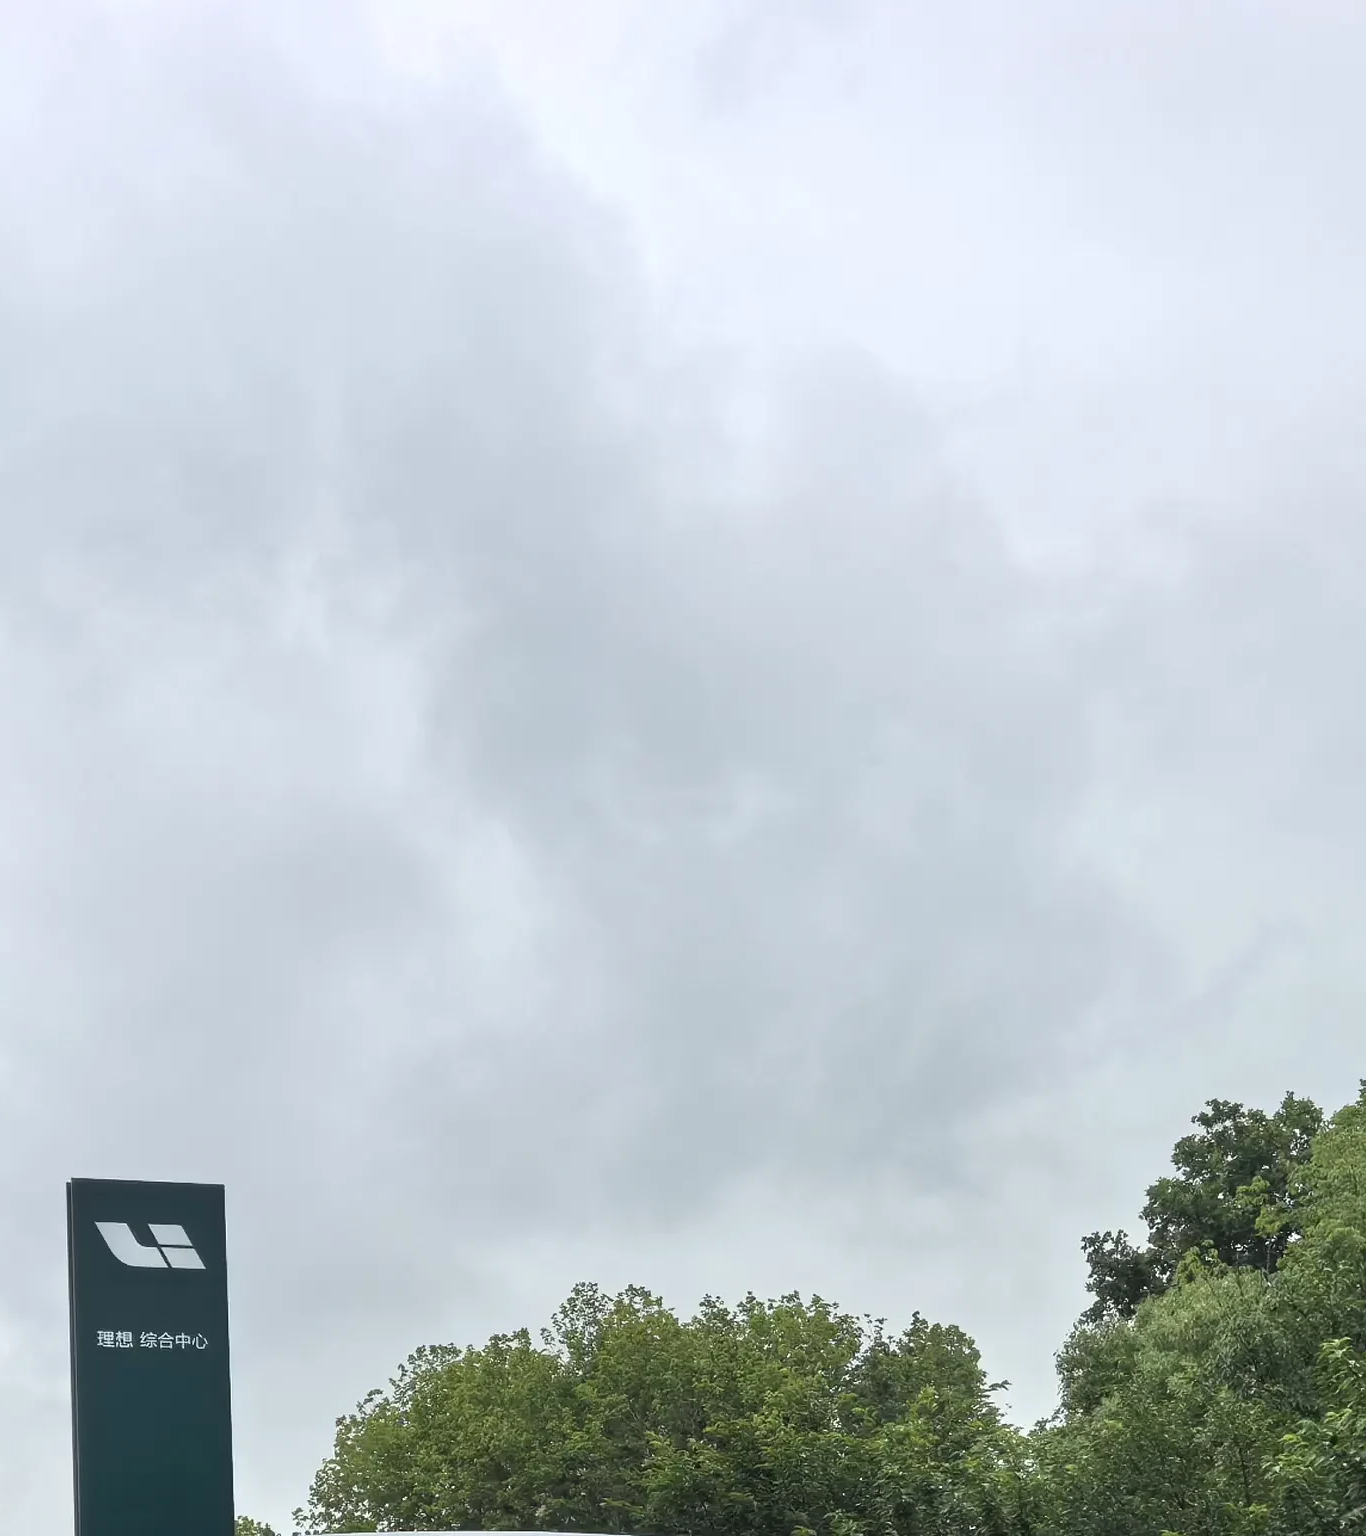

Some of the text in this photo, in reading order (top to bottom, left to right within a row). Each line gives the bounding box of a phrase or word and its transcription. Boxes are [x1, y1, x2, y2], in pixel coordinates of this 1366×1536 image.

[96, 1330, 209, 1350] 理想 综合中心
